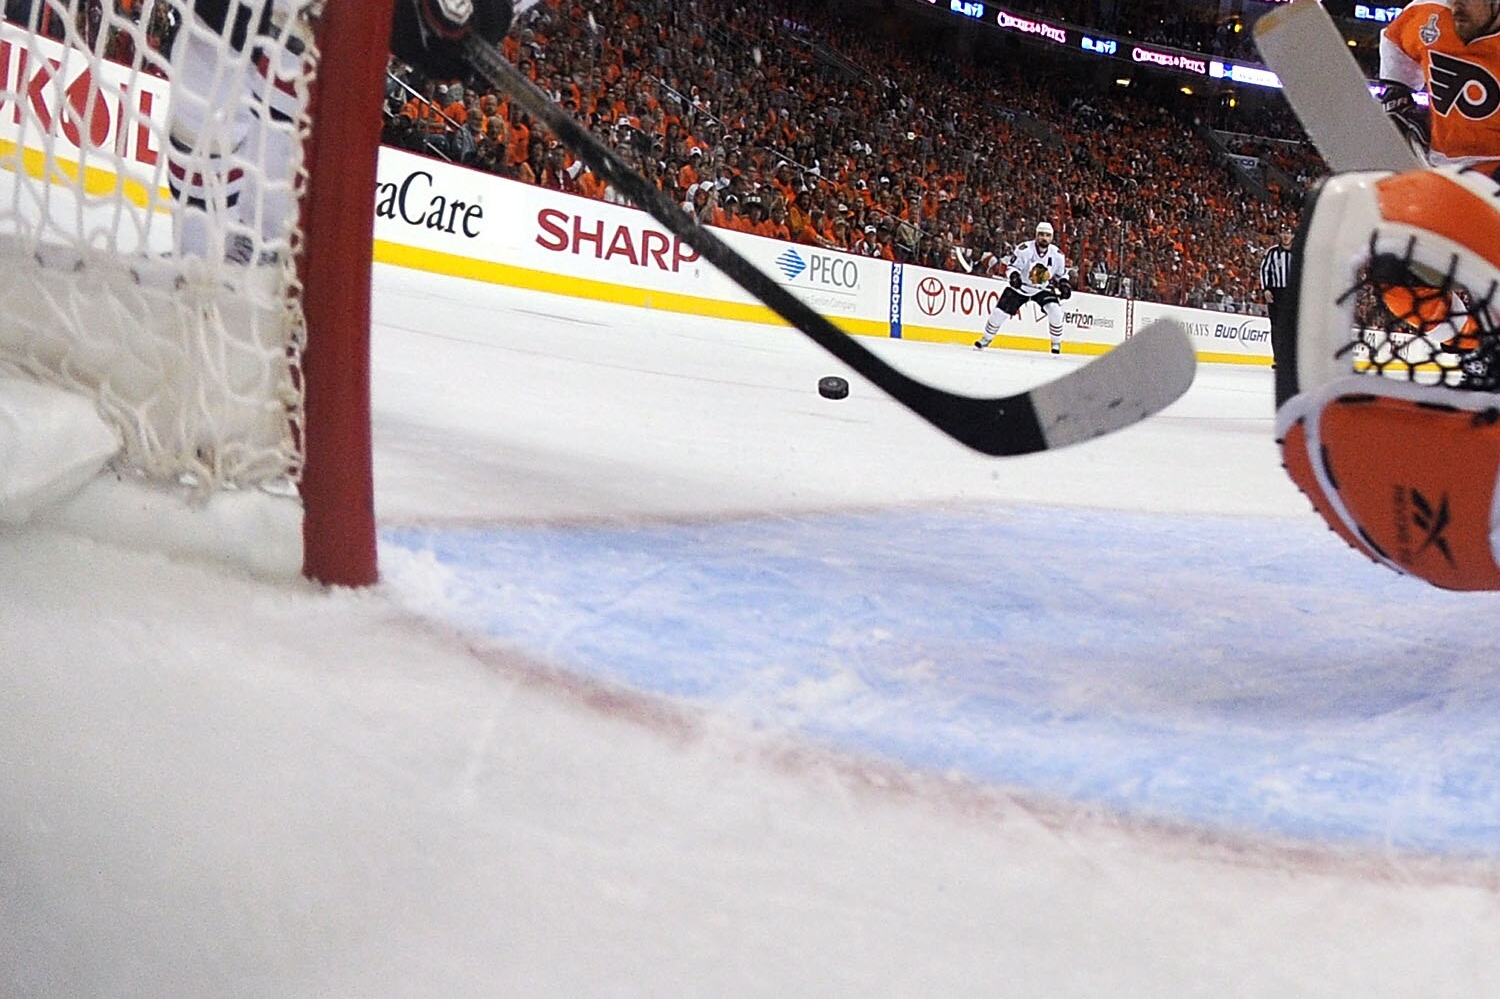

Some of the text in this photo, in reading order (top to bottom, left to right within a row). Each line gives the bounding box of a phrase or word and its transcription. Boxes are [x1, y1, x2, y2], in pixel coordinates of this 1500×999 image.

[535, 207, 702, 274] SHARP
[810, 253, 858, 290] PECO
[891, 262, 902, 325] Reebok
[1214, 324, 1271, 342] BUD LIGHT
